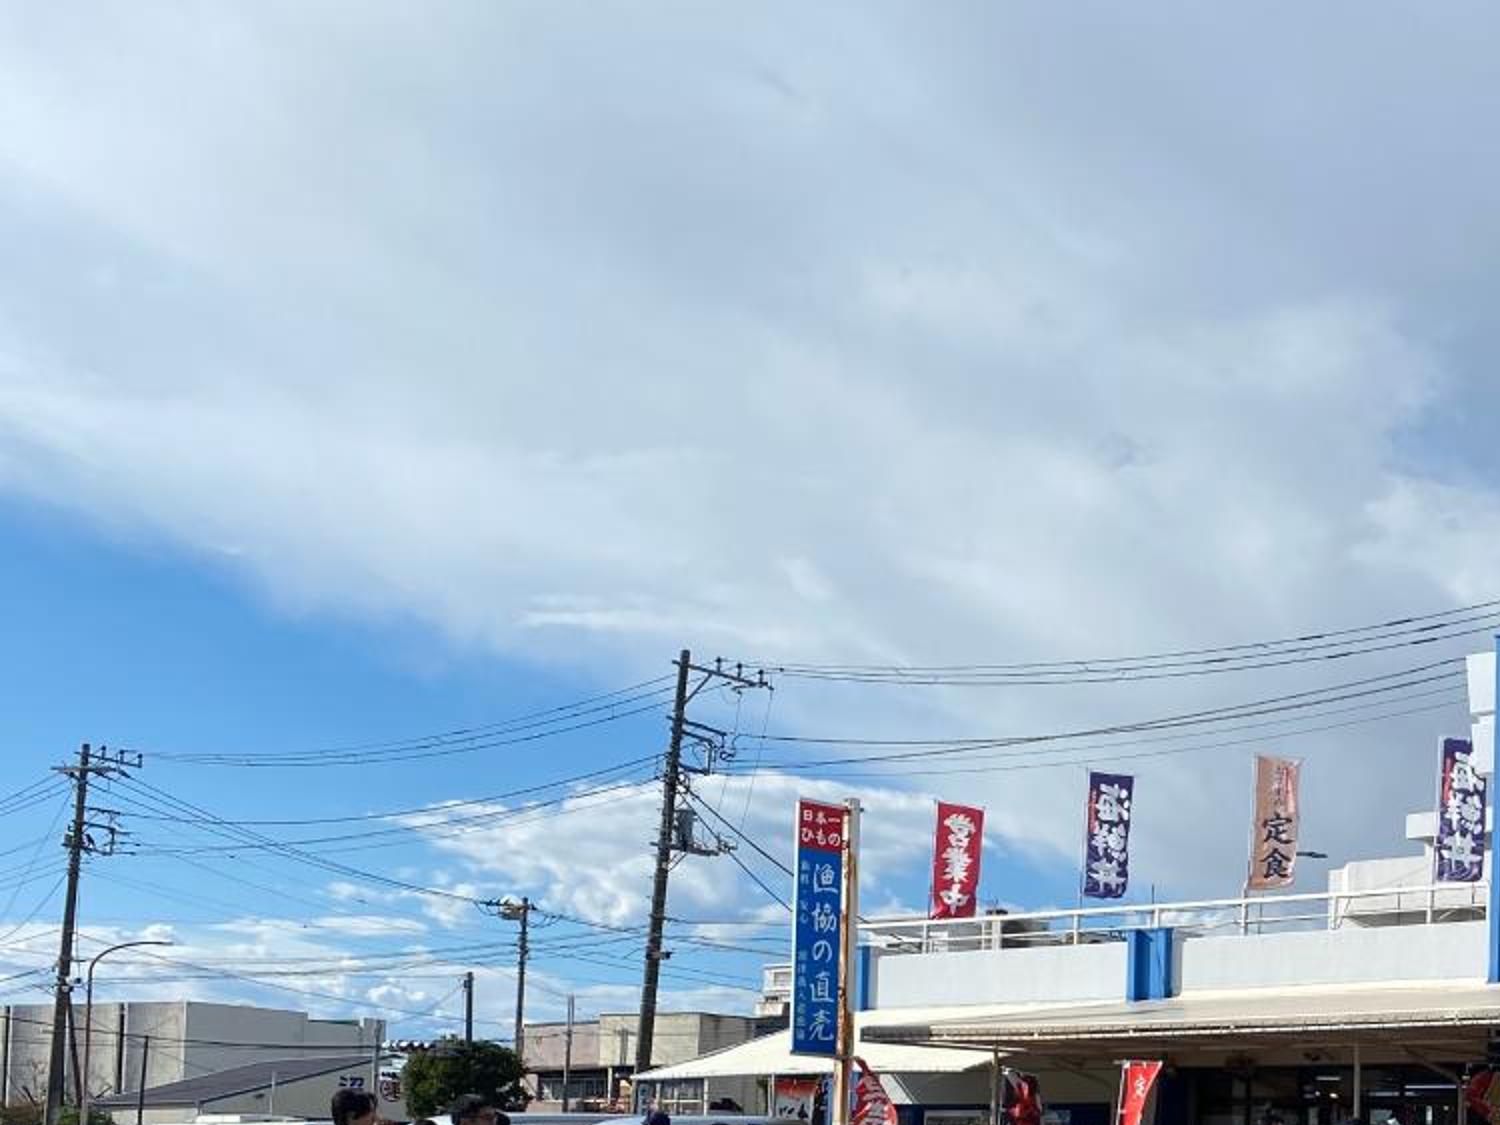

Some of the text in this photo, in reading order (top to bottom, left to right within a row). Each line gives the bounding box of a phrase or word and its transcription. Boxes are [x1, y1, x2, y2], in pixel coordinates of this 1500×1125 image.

[801, 828, 840, 845] ひもの
[803, 809, 840, 823] 日本一
[1261, 811, 1294, 878] 定食
[941, 814, 976, 916] 営業中
[808, 863, 838, 1041] 漁協の直売
